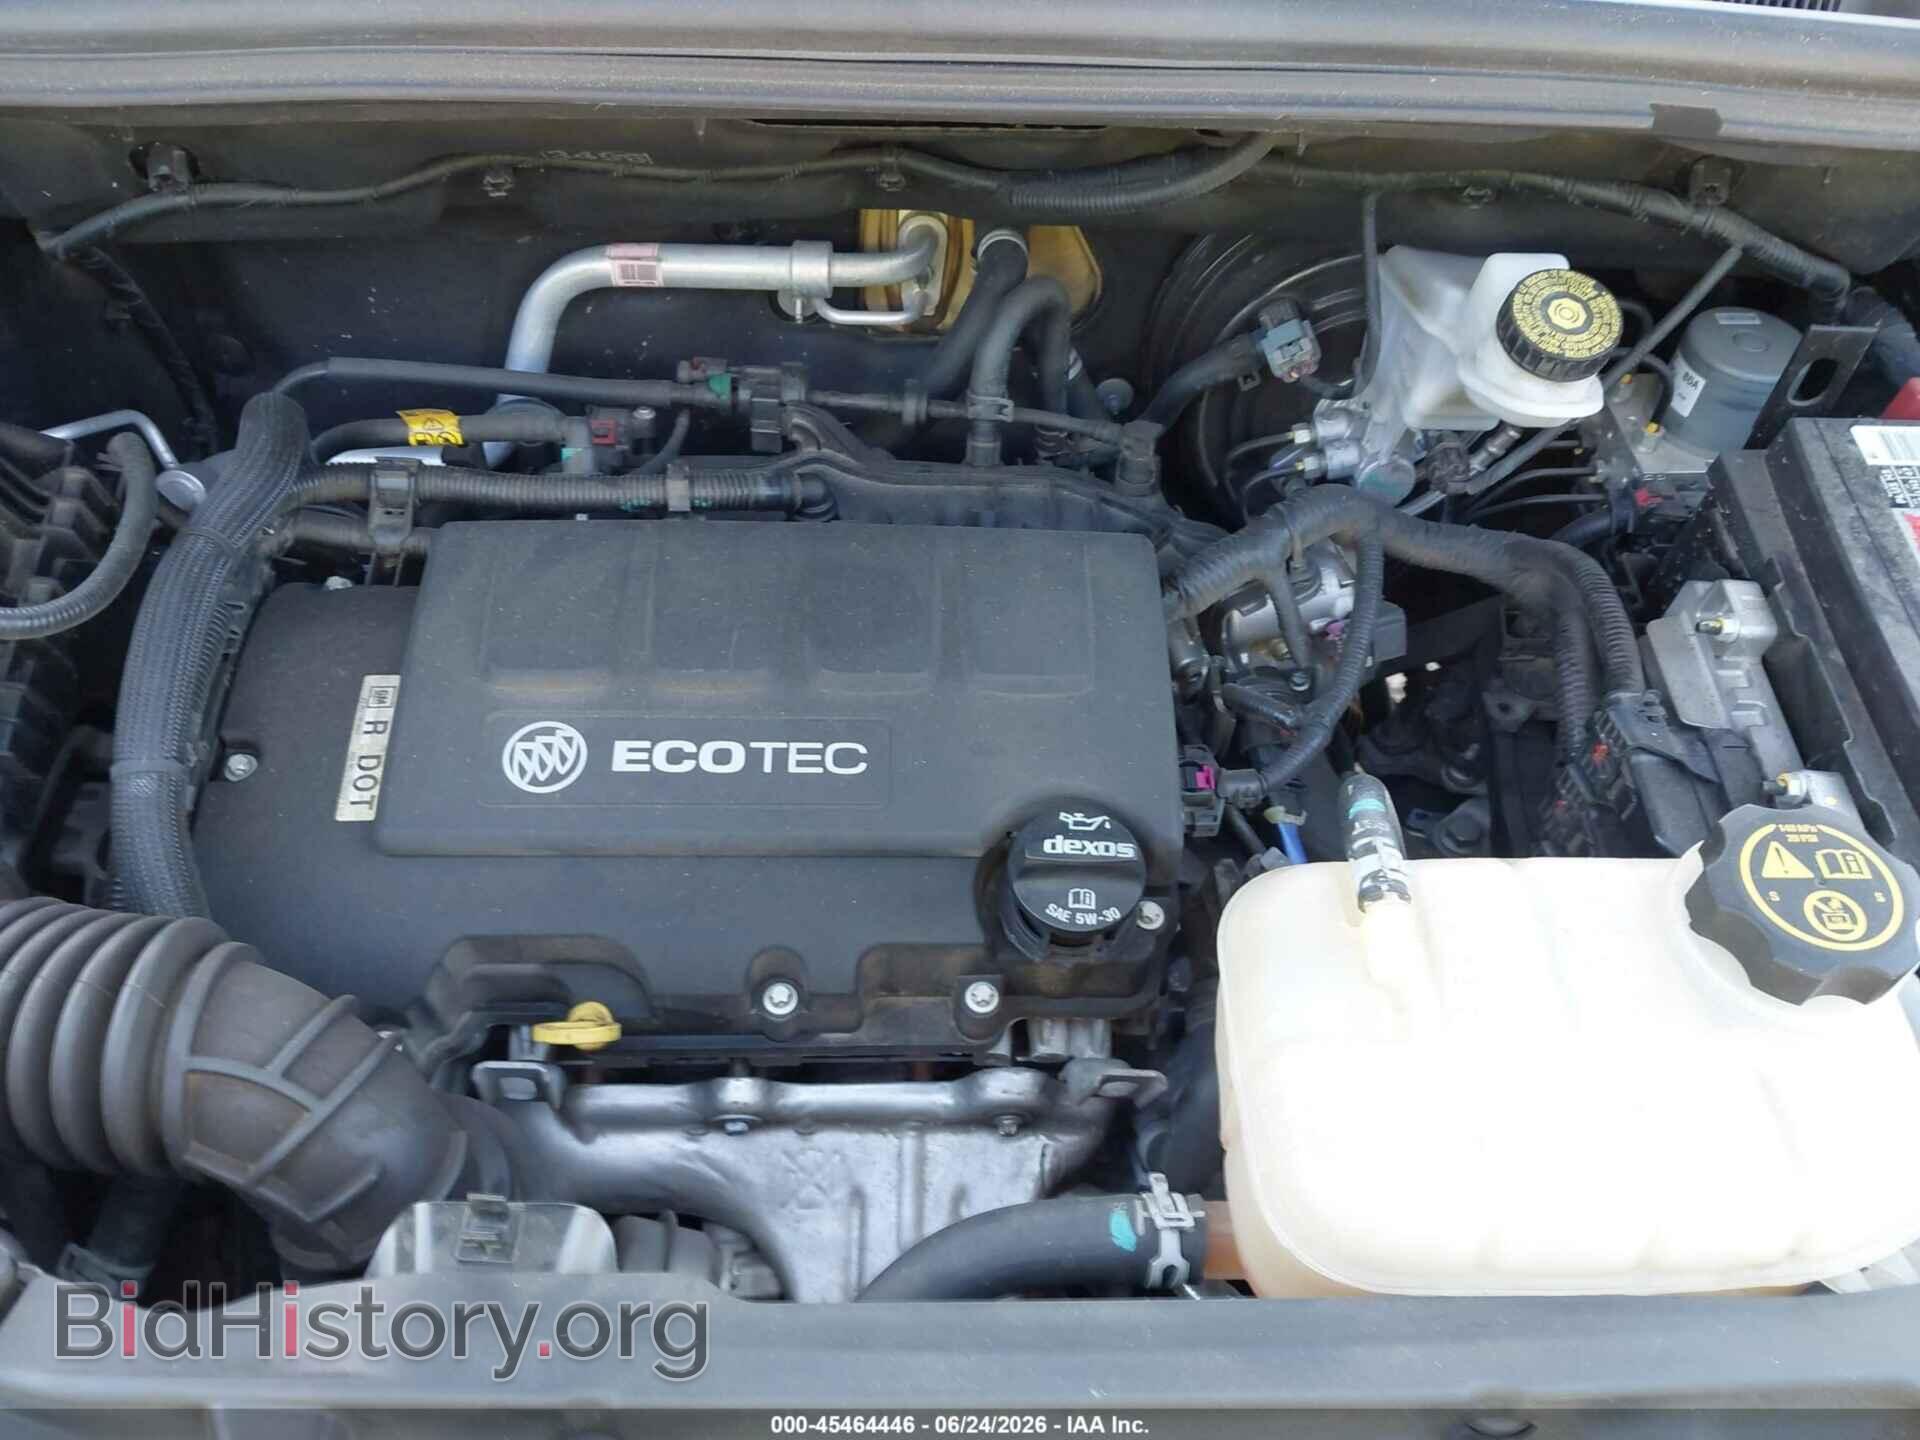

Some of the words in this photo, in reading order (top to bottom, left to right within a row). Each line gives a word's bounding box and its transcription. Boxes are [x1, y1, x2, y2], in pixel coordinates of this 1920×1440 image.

[363, 720, 388, 734] R
[611, 739, 869, 775] ECOTEC
[350, 754, 382, 811] DOT
[1043, 835, 1136, 858] dexos
[1045, 903, 1072, 923] SAE
[1075, 906, 1121, 925] 5W-30
